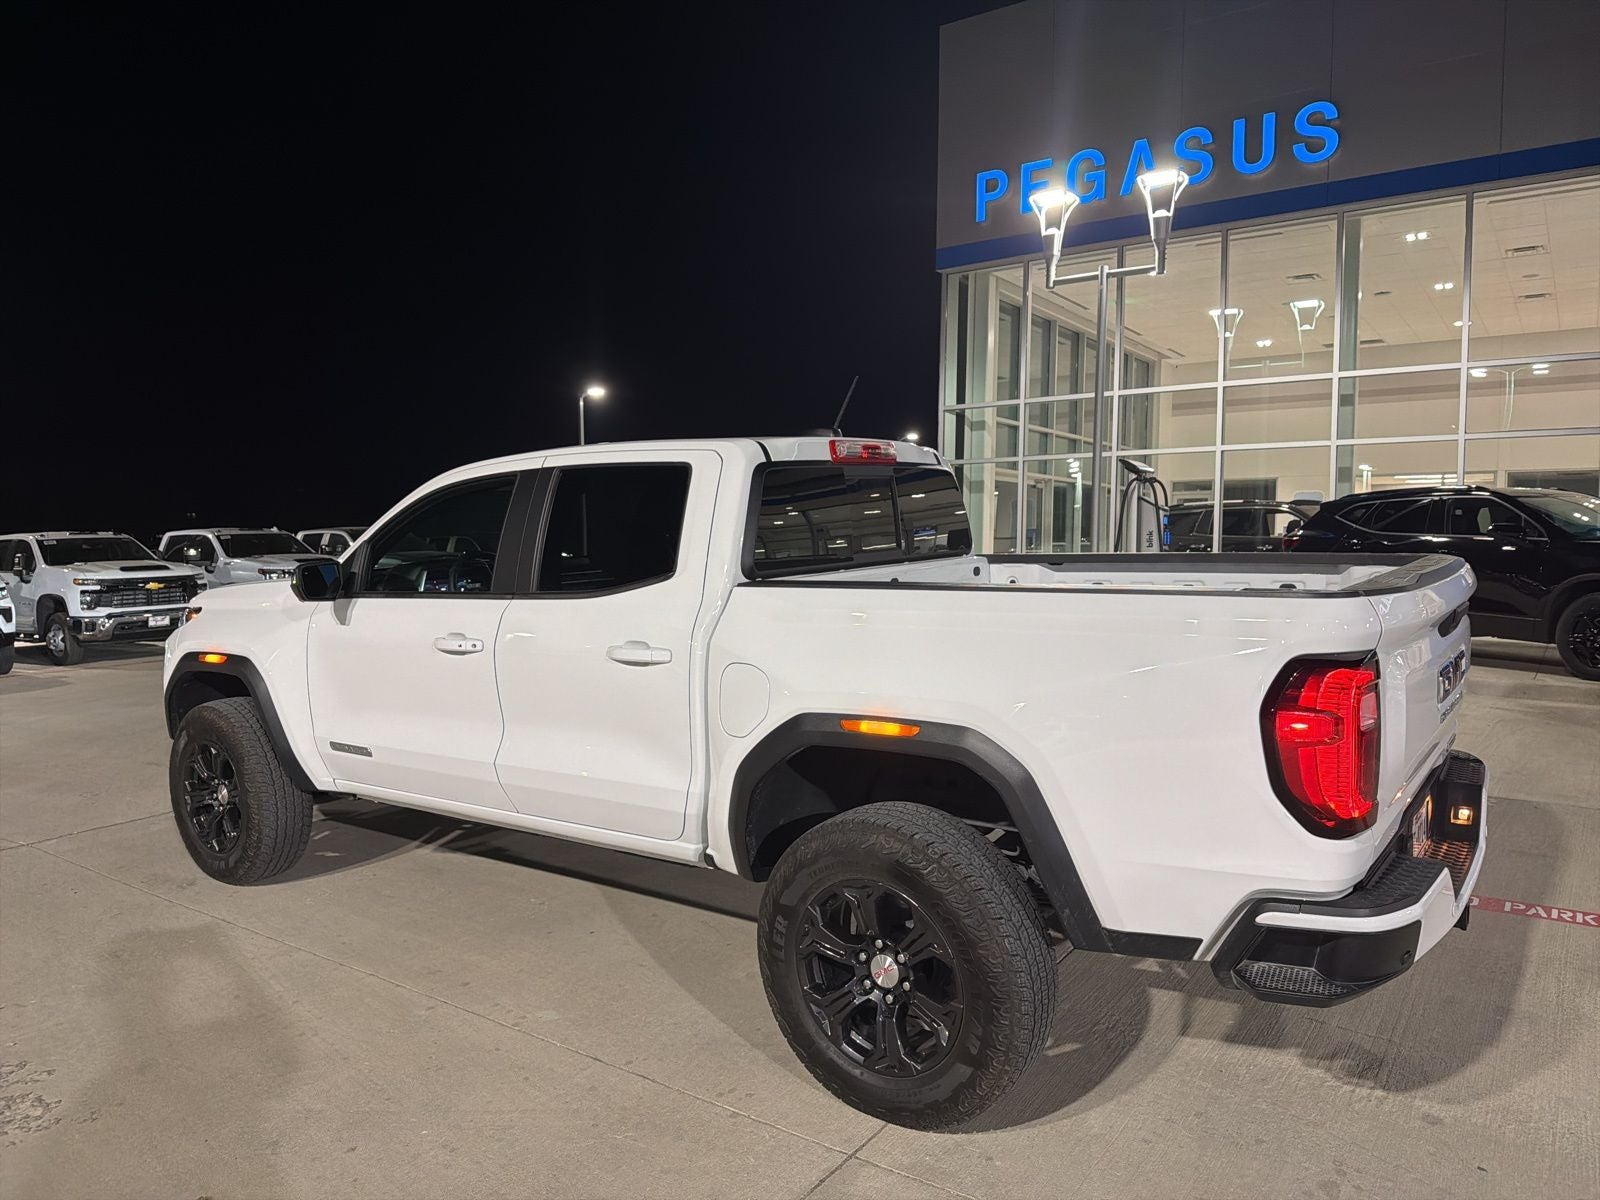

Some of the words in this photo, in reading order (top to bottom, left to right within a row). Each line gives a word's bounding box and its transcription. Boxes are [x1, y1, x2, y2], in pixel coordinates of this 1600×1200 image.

[975, 100, 1340, 223] PEGASUS
[1146, 530, 1154, 549] blink
[1504, 900, 1599, 926] PARK
[874, 965, 895, 980] GMC
